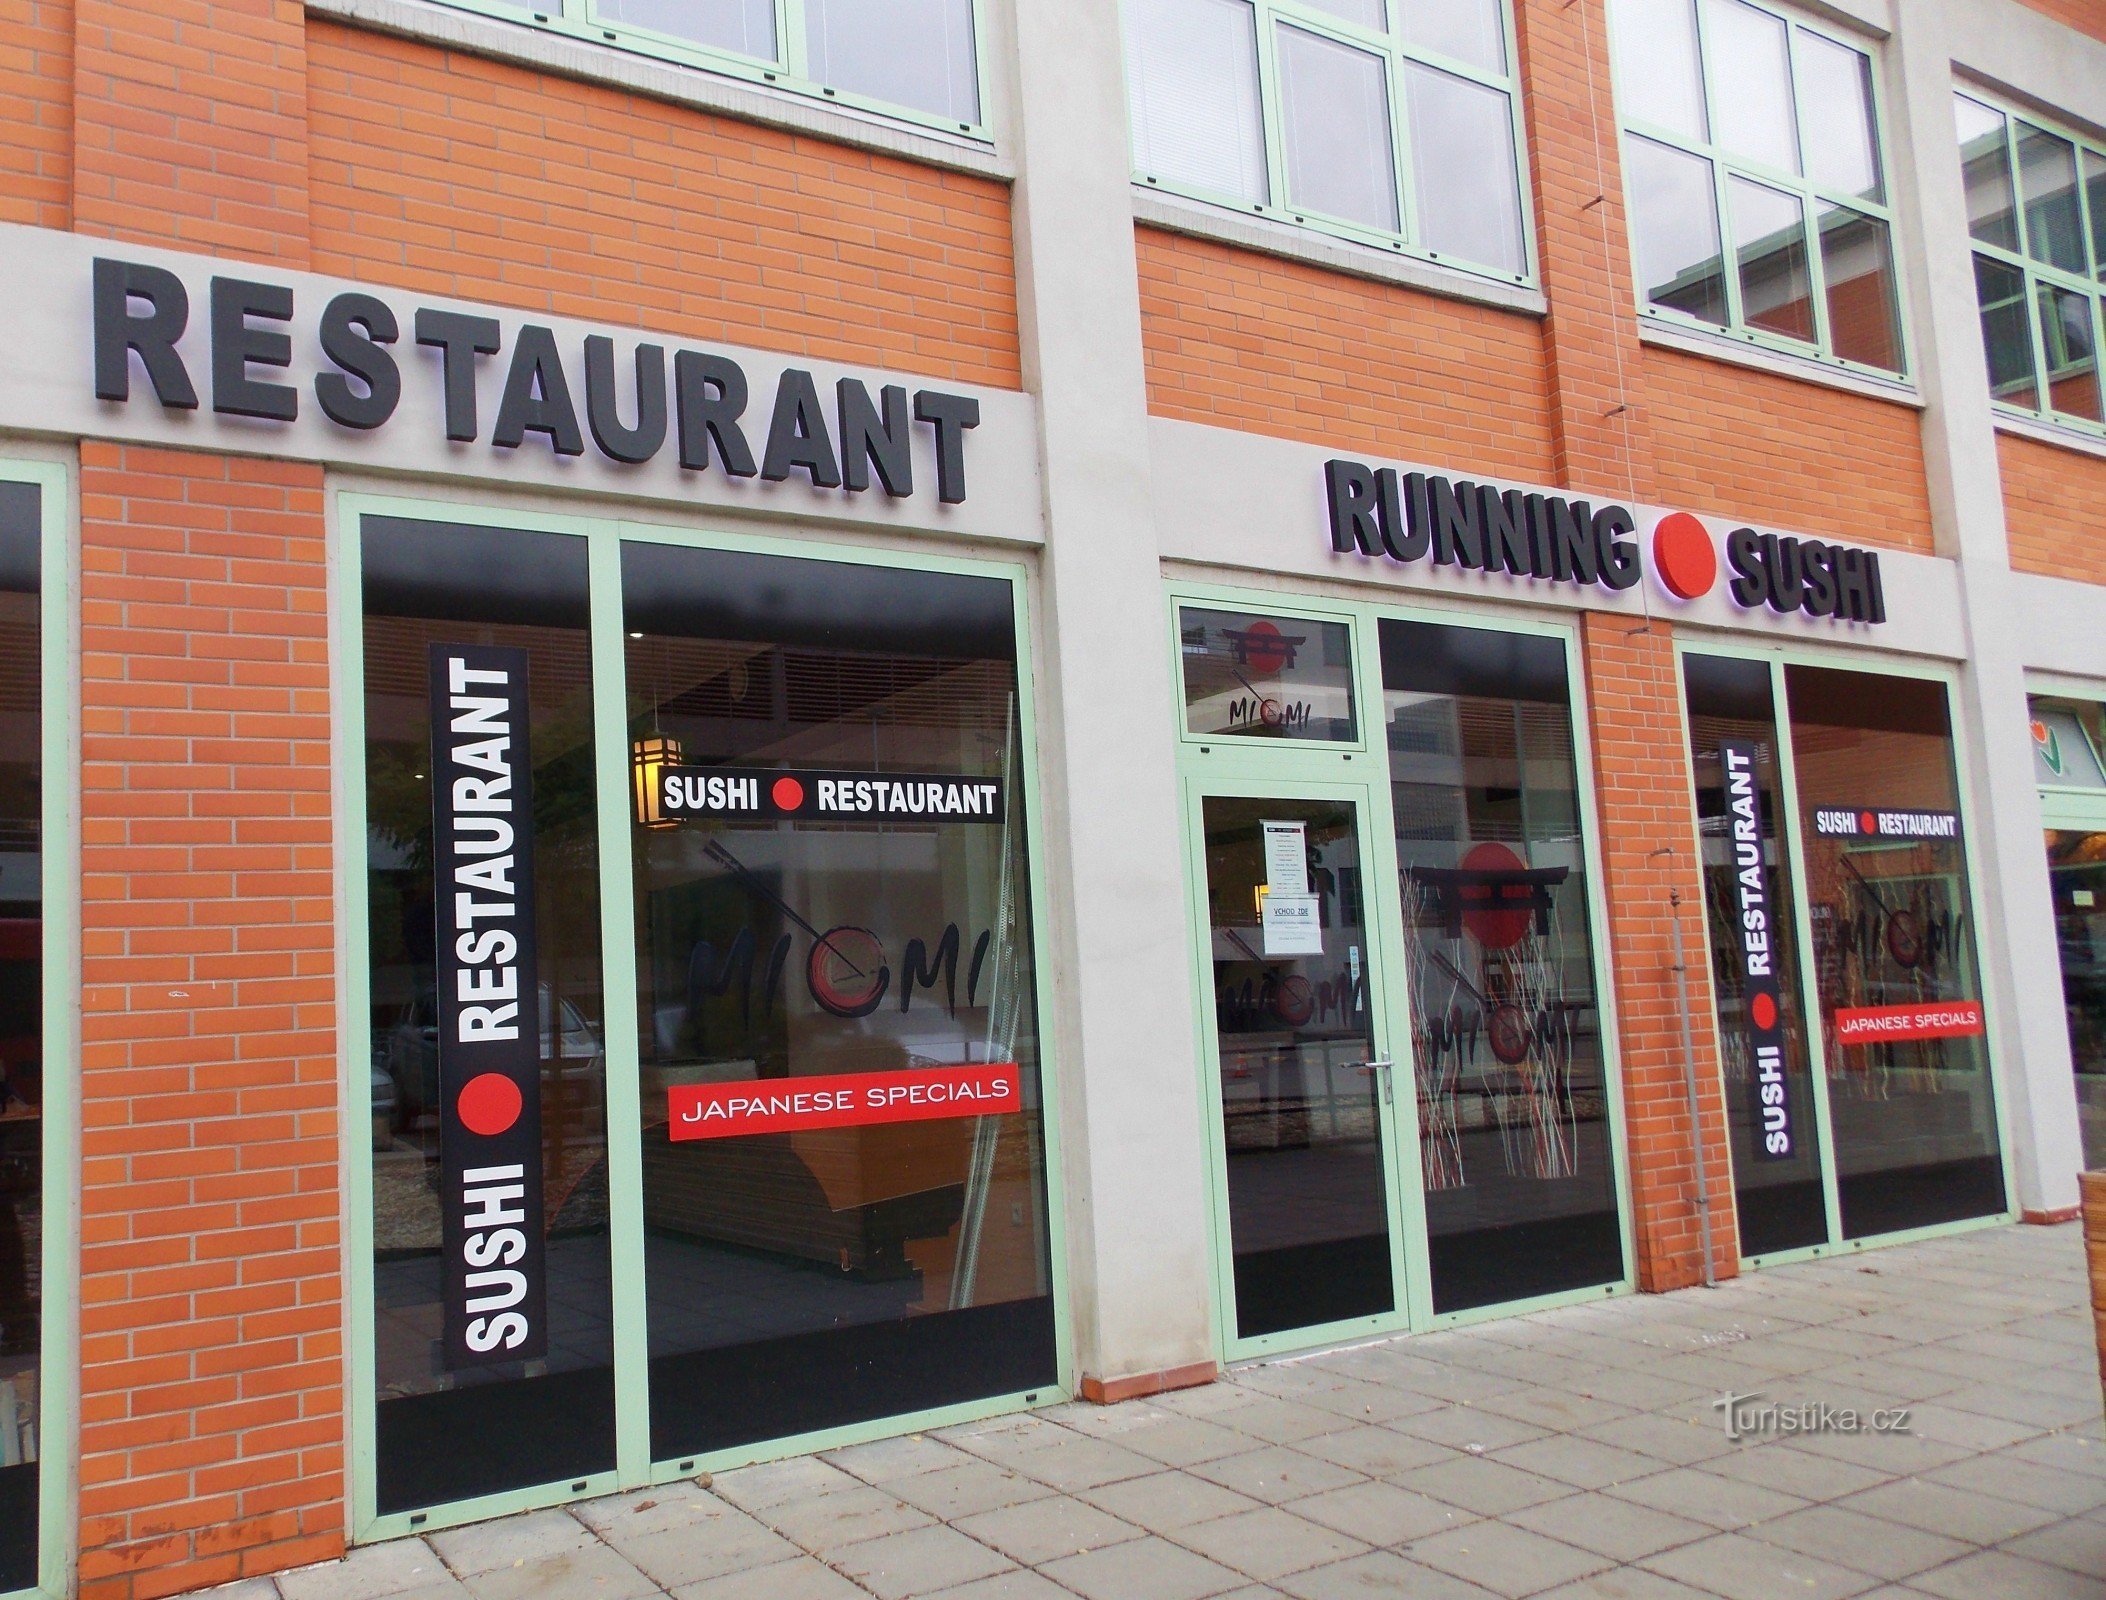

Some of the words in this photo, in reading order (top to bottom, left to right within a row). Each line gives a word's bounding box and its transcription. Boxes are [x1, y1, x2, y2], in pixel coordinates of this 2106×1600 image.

[92, 257, 980, 505] RESTAURANT
[1324, 458, 1642, 591] RUNNING
[1728, 527, 1887, 624] SUSHI
[1229, 697, 1311, 729] MIOMI
[664, 776, 758, 810] SUSHI
[818, 779, 997, 814] RESTAURANT
[1817, 810, 1857, 835] SUSHI
[1878, 813, 1955, 837] RESTAURANT
[448, 657, 520, 1044] RESTAURANT
[1726, 747, 1771, 976] RESTAURANT
[686, 922, 990, 1026] MIOMI
[1841, 1014, 1911, 1034] JAPANESE
[1915, 1010, 1977, 1028] SPECIALS
[681, 1090, 854, 1122] JAPANESE
[866, 1079, 1010, 1108] SPECIALS
[1756, 1045, 1790, 1155] SUSHI
[464, 1162, 529, 1353] SUSHI
